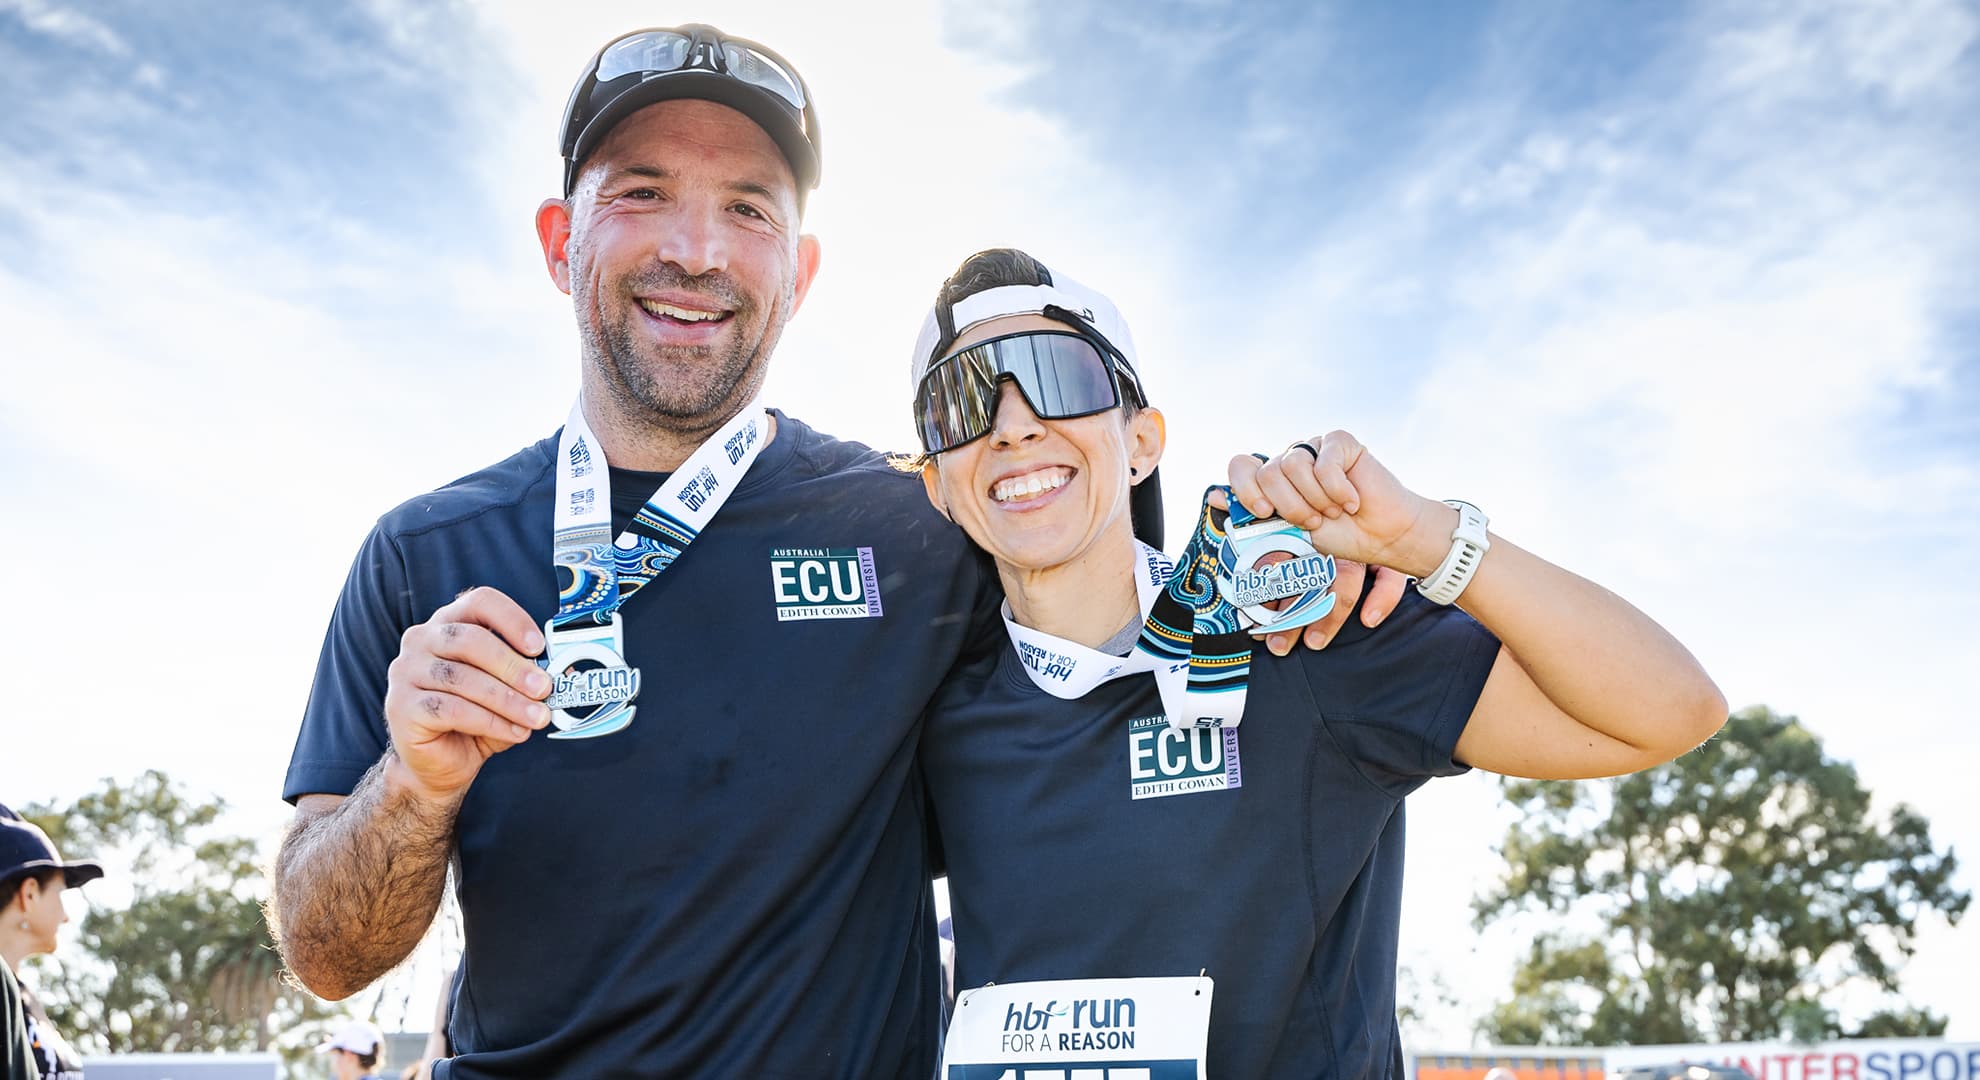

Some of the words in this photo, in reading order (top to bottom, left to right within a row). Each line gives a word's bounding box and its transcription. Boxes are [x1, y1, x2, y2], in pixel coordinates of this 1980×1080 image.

[724, 431, 743, 452] REASON
[728, 442, 745, 466] run
[677, 479, 699, 503] REASON
[702, 473, 719, 497] hbf
[685, 490, 707, 512] run
[773, 548, 824, 557] AUSTRALIA
[771, 560, 861, 603] ECU
[861, 551, 880, 614] UNIVERSITY
[1148, 557, 1161, 586] REASON
[1235, 567, 1270, 593] hbf
[1281, 556, 1325, 582] run
[1236, 589, 1260, 604] FOR
[1261, 586, 1272, 600] A
[1276, 574, 1328, 595] REASON
[780, 608, 819, 618] EDITH
[822, 606, 867, 616] COWAN
[1019, 640, 1047, 659] REASON
[1020, 649, 1039, 671] run
[1050, 652, 1056, 661] A
[1042, 663, 1072, 681] hbf
[1057, 655, 1077, 668] FOR
[551, 673, 577, 695] bf
[587, 668, 628, 690] run
[549, 693, 563, 706] OR
[565, 692, 575, 704] A
[580, 687, 629, 702] REASON
[1133, 715, 1168, 728] AUSTRA
[1129, 727, 1222, 779] ECU
[1226, 729, 1239, 784] UNIVERS
[1135, 783, 1174, 796] EDITH
[1178, 776, 1225, 791] COWAN
[1003, 1000, 1060, 1031] hbf
[1073, 997, 1136, 1029] run
[1002, 1033, 1034, 1053] FOR
[1040, 1033, 1052, 1052] A
[1059, 1031, 1135, 1051] REASON
